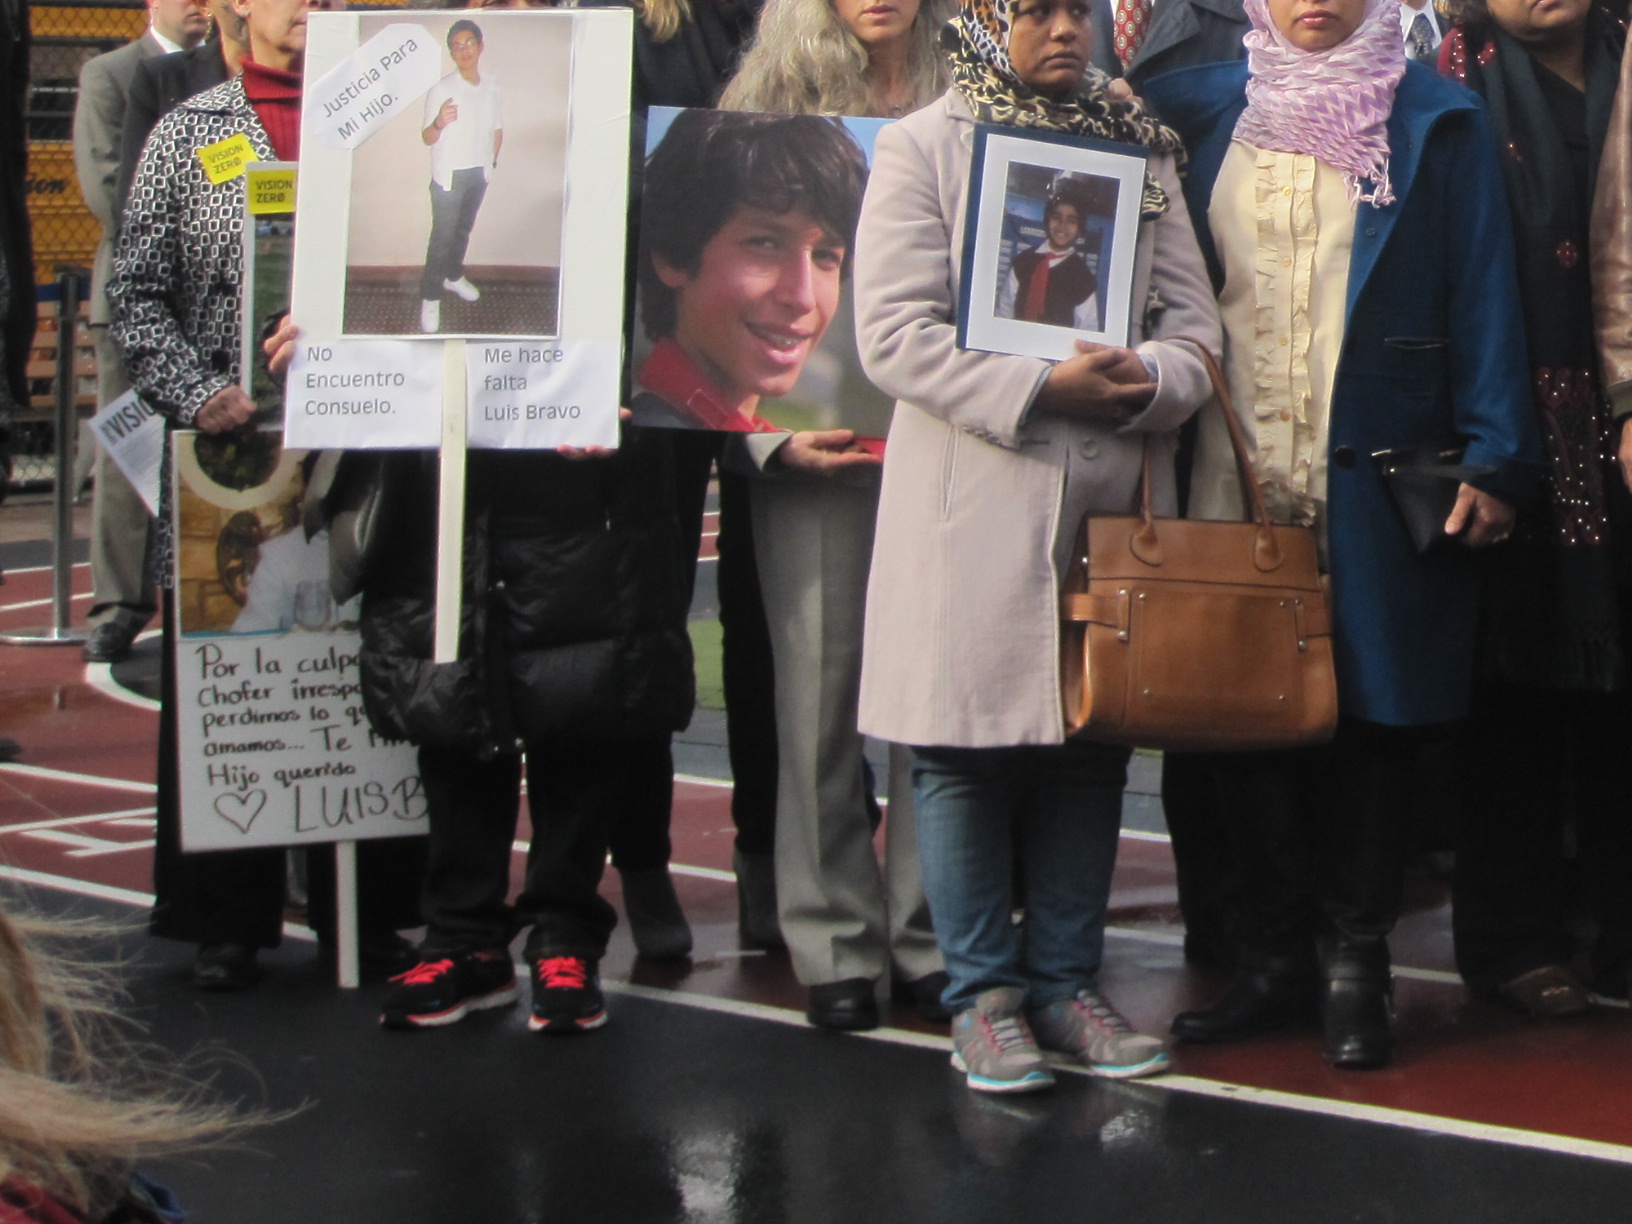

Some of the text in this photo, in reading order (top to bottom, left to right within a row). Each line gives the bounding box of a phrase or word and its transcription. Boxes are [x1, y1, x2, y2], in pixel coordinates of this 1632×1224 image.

[323, 39, 418, 118] Justicia Para
[337, 93, 398, 140] Mi Hijo.
[208, 144, 244, 163] VISION
[255, 179, 293, 190] VISION
[307, 346, 333, 362] No
[484, 346, 564, 363] Me hace
[305, 371, 405, 389] Encuentro
[484, 375, 528, 391] falta
[305, 398, 397, 416] Consuelo.
[484, 404, 581, 421] Luis Bravo
[195, 643, 240, 680] Por
[256, 646, 282, 674] la
[202, 705, 300, 738] perdimos
[310, 705, 330, 722] lo
[310, 724, 352, 752] Te
[207, 762, 357, 792] Hijo querido
